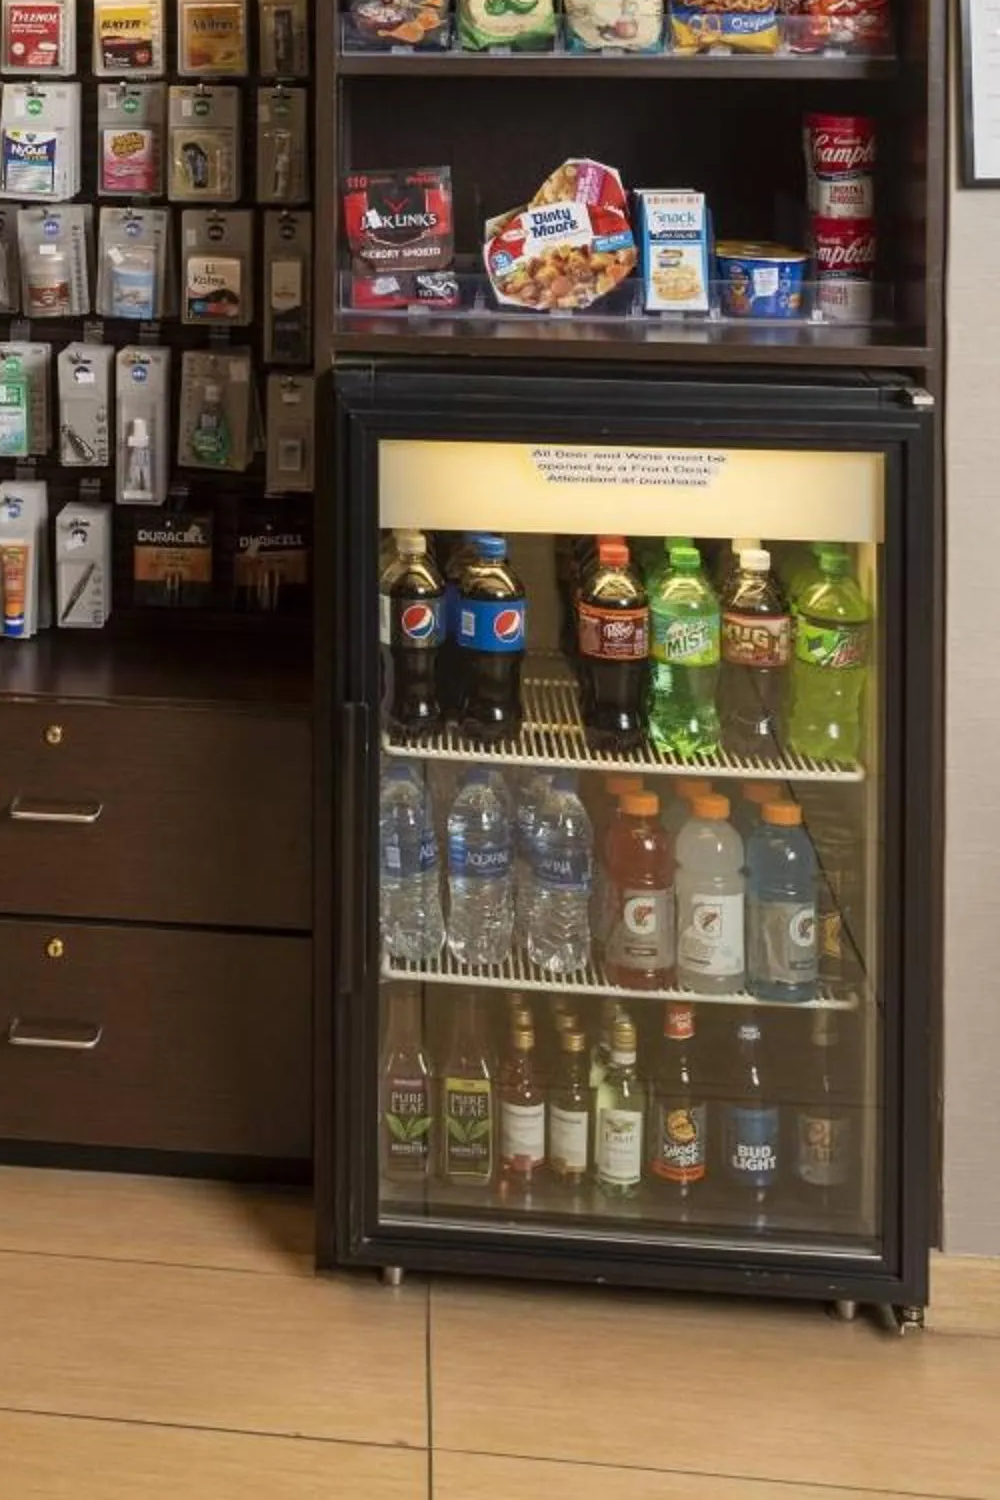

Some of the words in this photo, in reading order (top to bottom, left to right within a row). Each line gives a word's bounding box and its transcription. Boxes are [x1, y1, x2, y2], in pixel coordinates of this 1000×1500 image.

[11, 9, 58, 24] TYLENOL
[11, 143, 48, 156] NyQuil
[531, 207, 572, 225] Dinty
[530, 220, 578, 239] Moore
[391, 1092, 424, 1103] PURE
[450, 1094, 486, 1105] PURE
[391, 1102, 424, 1114] LEAF
[451, 1104, 485, 1116] LEAF
[737, 1145, 772, 1157] BUD
[732, 1155, 777, 1171] LIGHT
